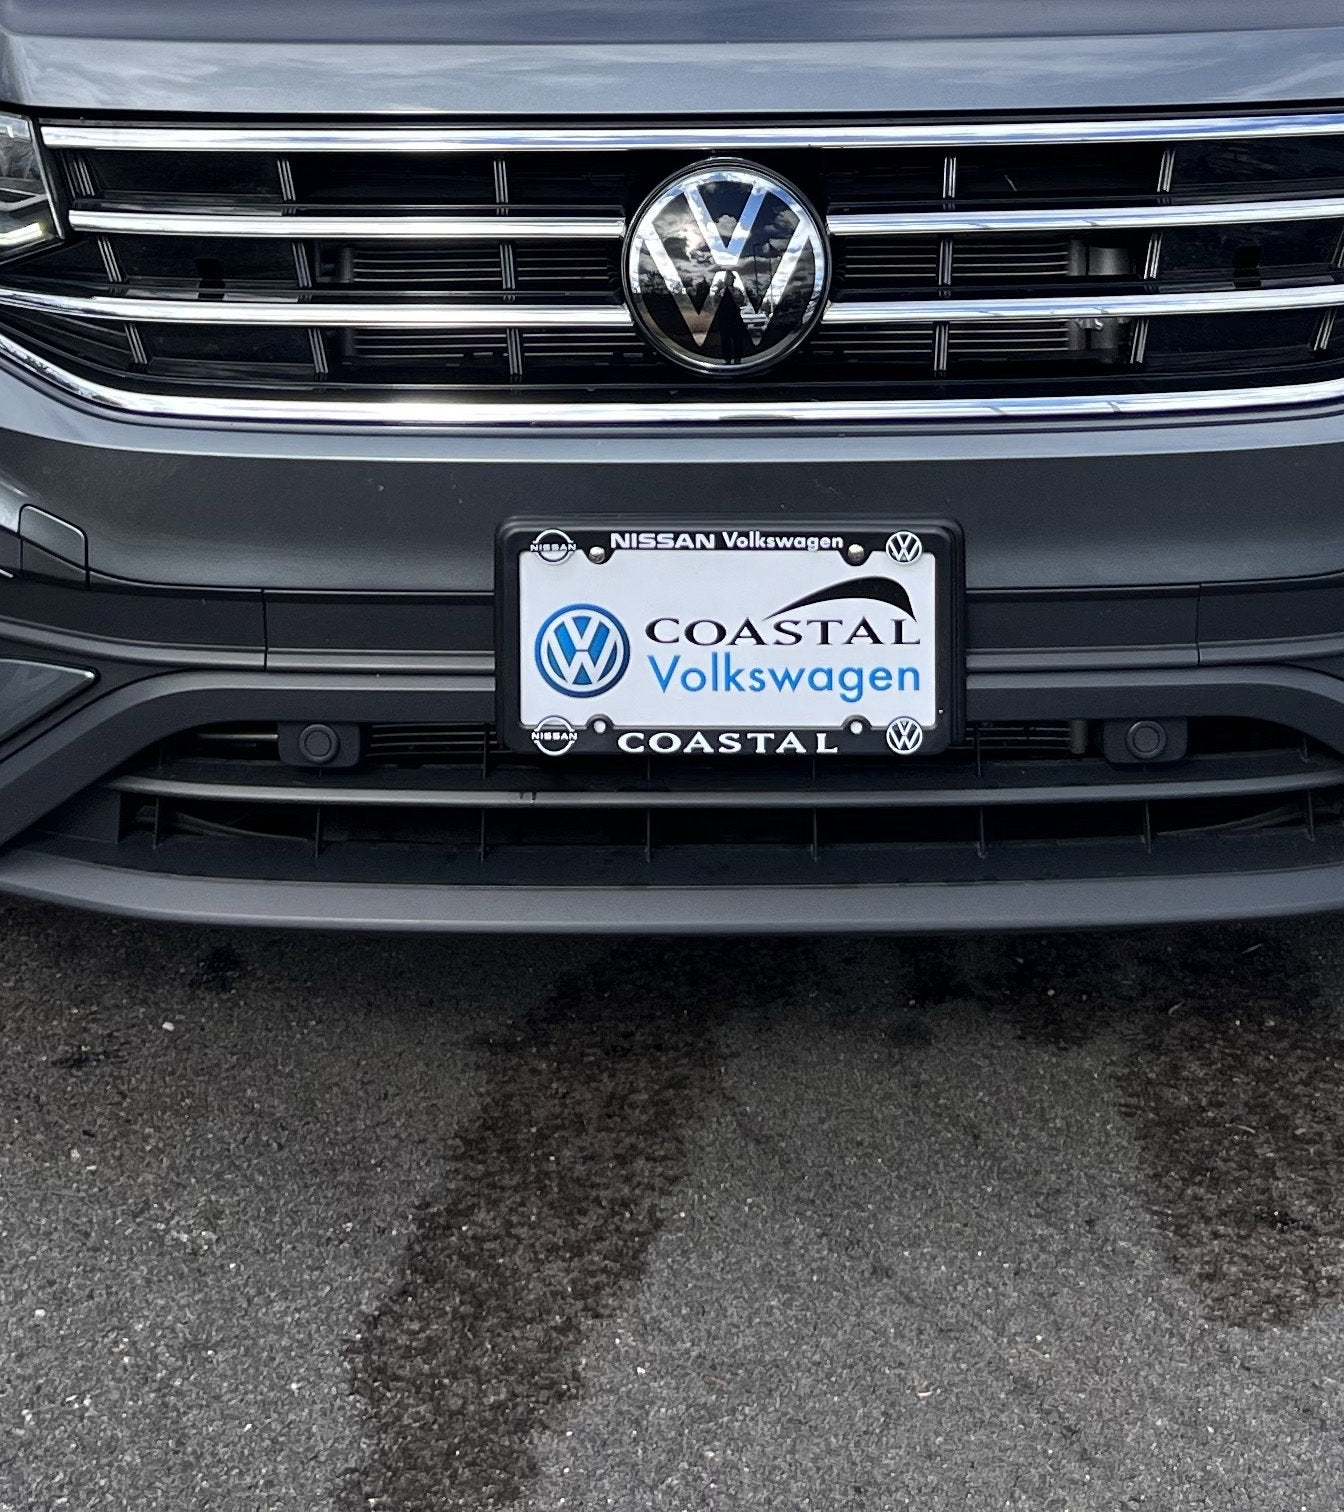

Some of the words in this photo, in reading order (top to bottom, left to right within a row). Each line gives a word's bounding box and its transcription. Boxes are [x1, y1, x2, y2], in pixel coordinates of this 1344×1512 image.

[530, 543, 576, 552] NISSAN
[610, 532, 715, 550] NISSAN
[721, 531, 844, 551] Volkswagen
[645, 616, 921, 647] COASTAL
[647, 651, 921, 704] Volkswagen
[531, 731, 578, 741] NISSAN
[617, 731, 839, 754] COASTAL
